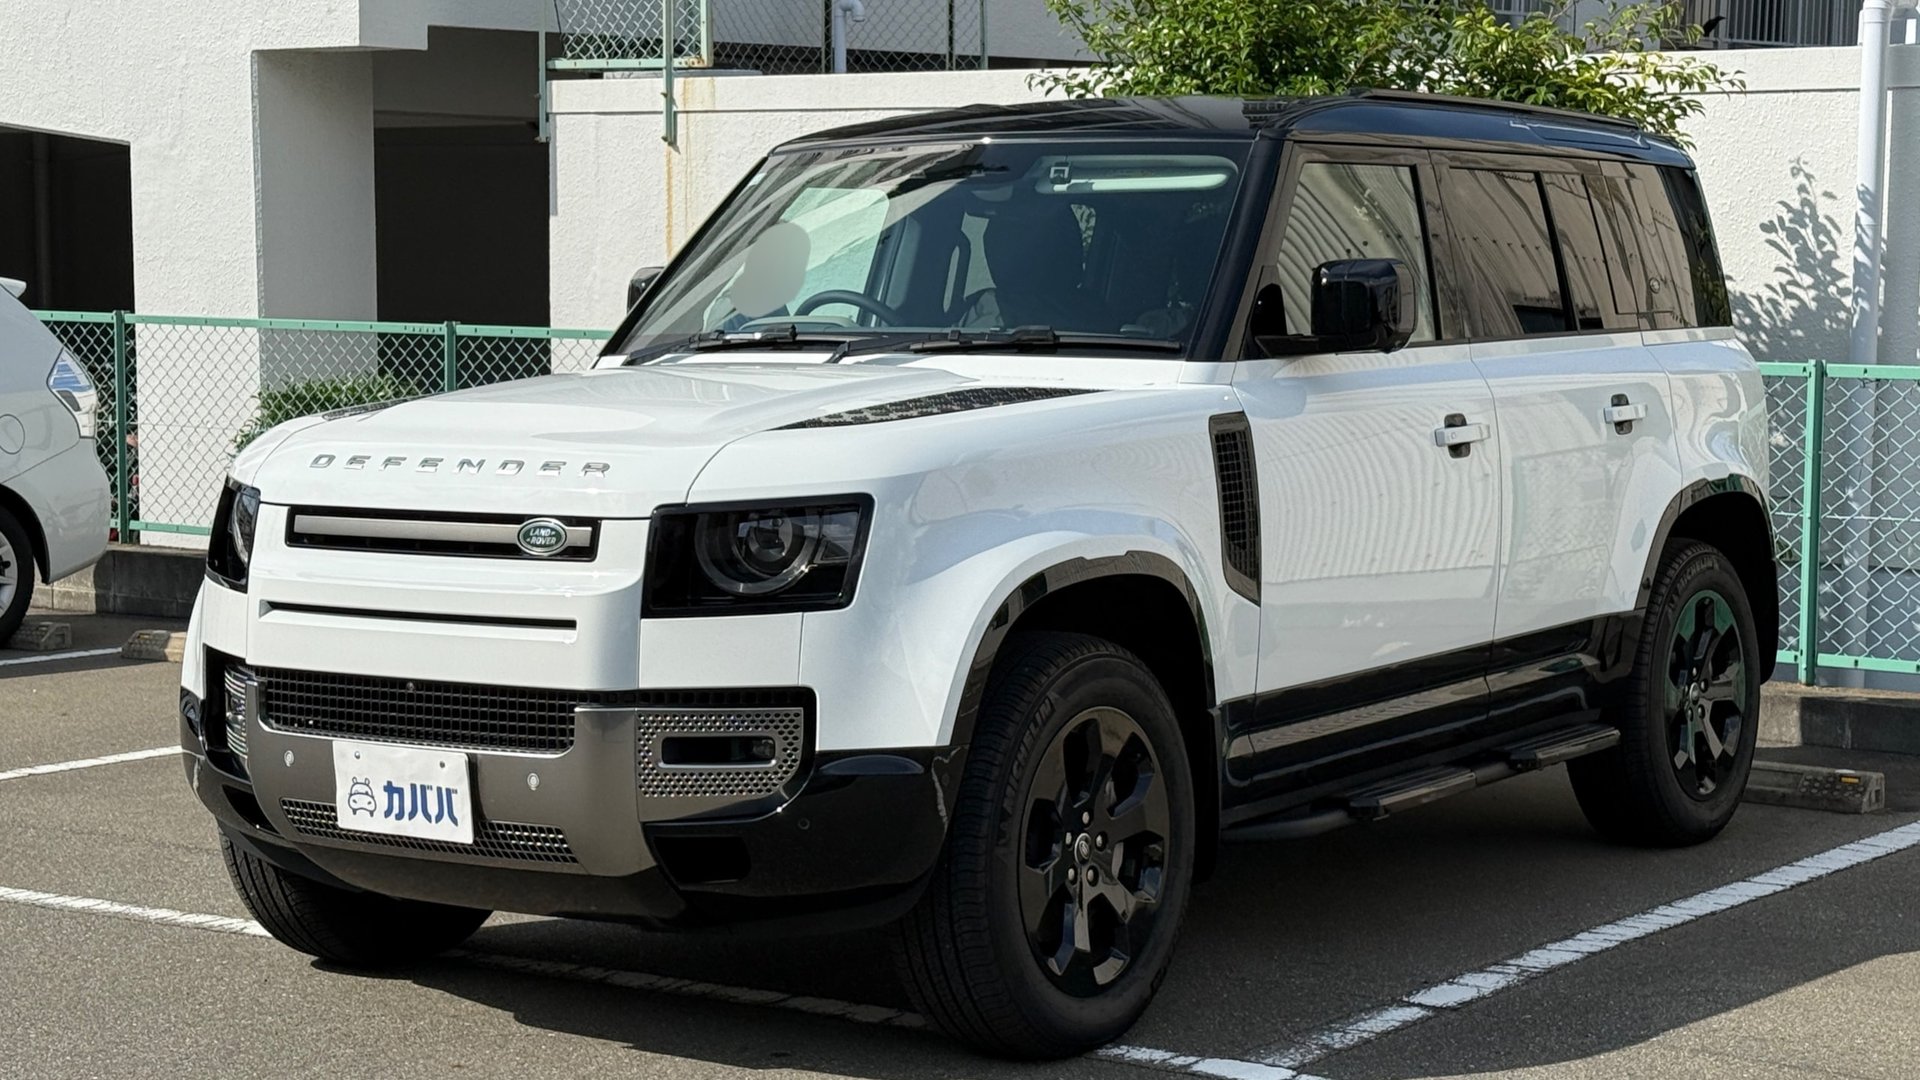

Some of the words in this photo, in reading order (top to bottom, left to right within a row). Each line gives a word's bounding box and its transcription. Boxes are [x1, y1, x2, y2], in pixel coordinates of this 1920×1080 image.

[309, 453, 611, 478] DEFENDER
[529, 528, 551, 537] LAND
[530, 536, 557, 545] ROVER
[1002, 696, 1056, 816] MICHELIN
[383, 780, 459, 827] カババ
